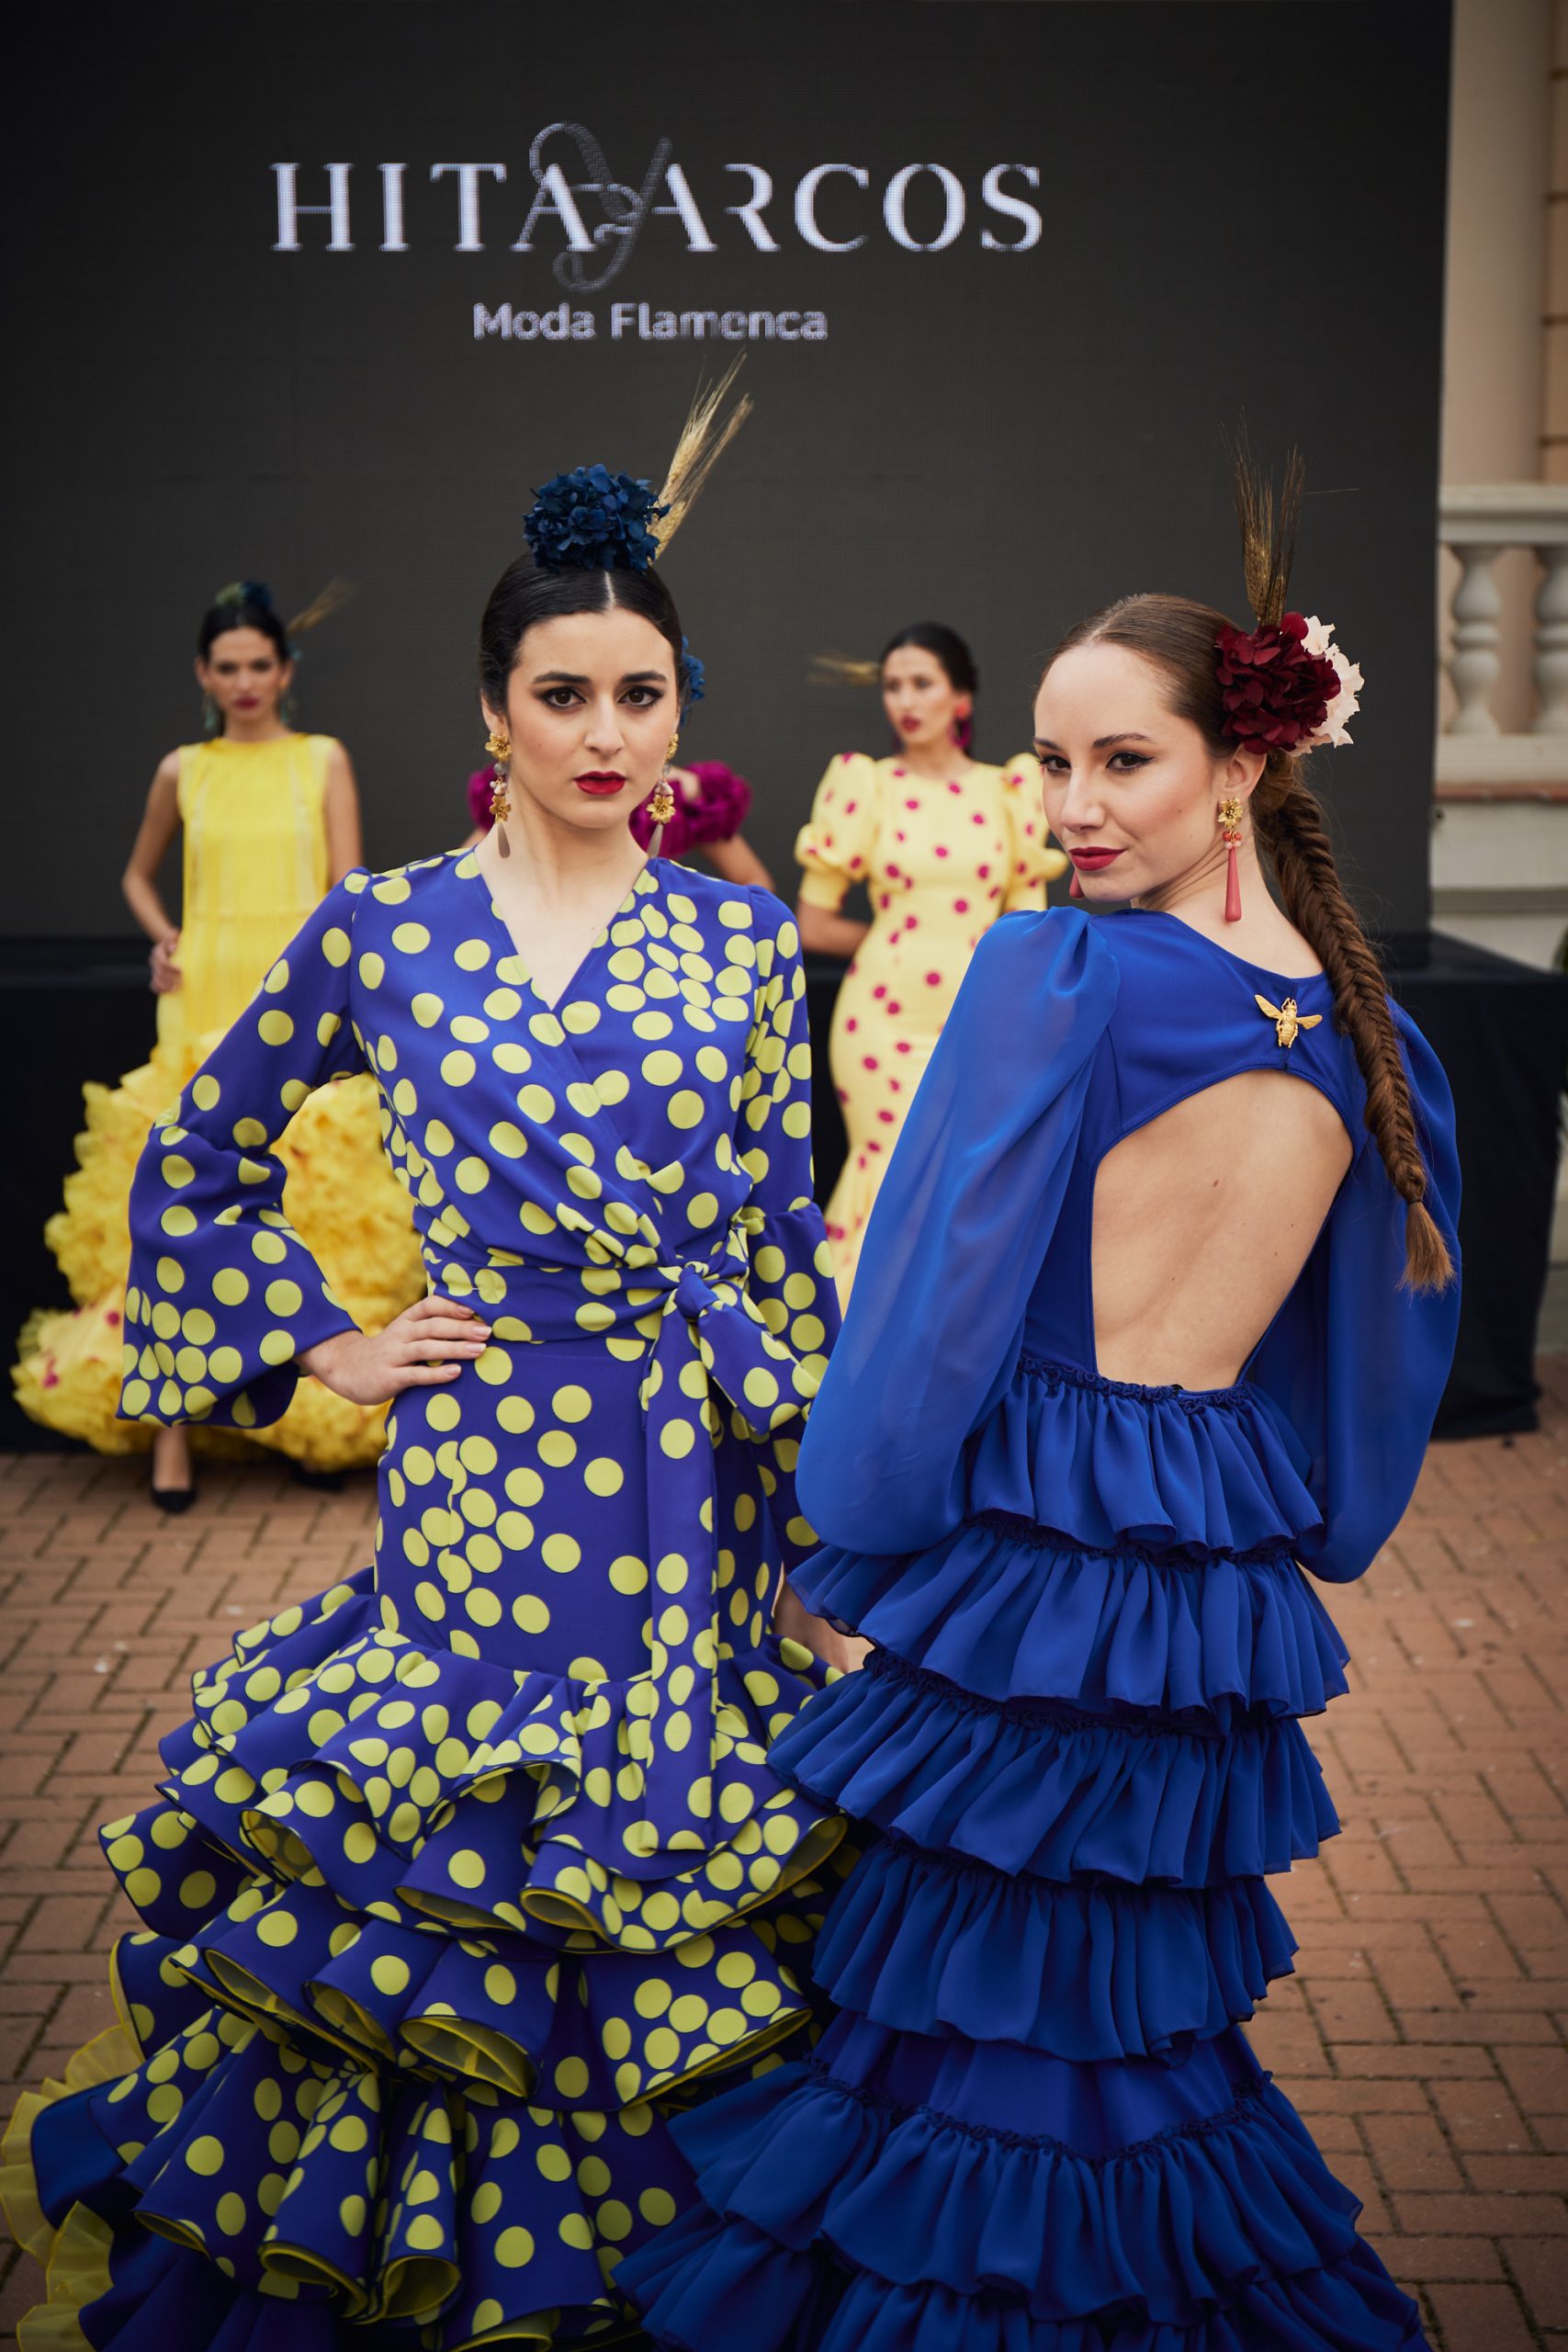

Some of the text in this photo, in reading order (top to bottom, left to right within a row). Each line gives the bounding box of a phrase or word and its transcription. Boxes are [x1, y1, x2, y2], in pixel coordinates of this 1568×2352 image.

[269, 163, 596, 252] HITA
[651, 163, 1043, 252] ARCOS
[472, 302, 596, 340] Moda
